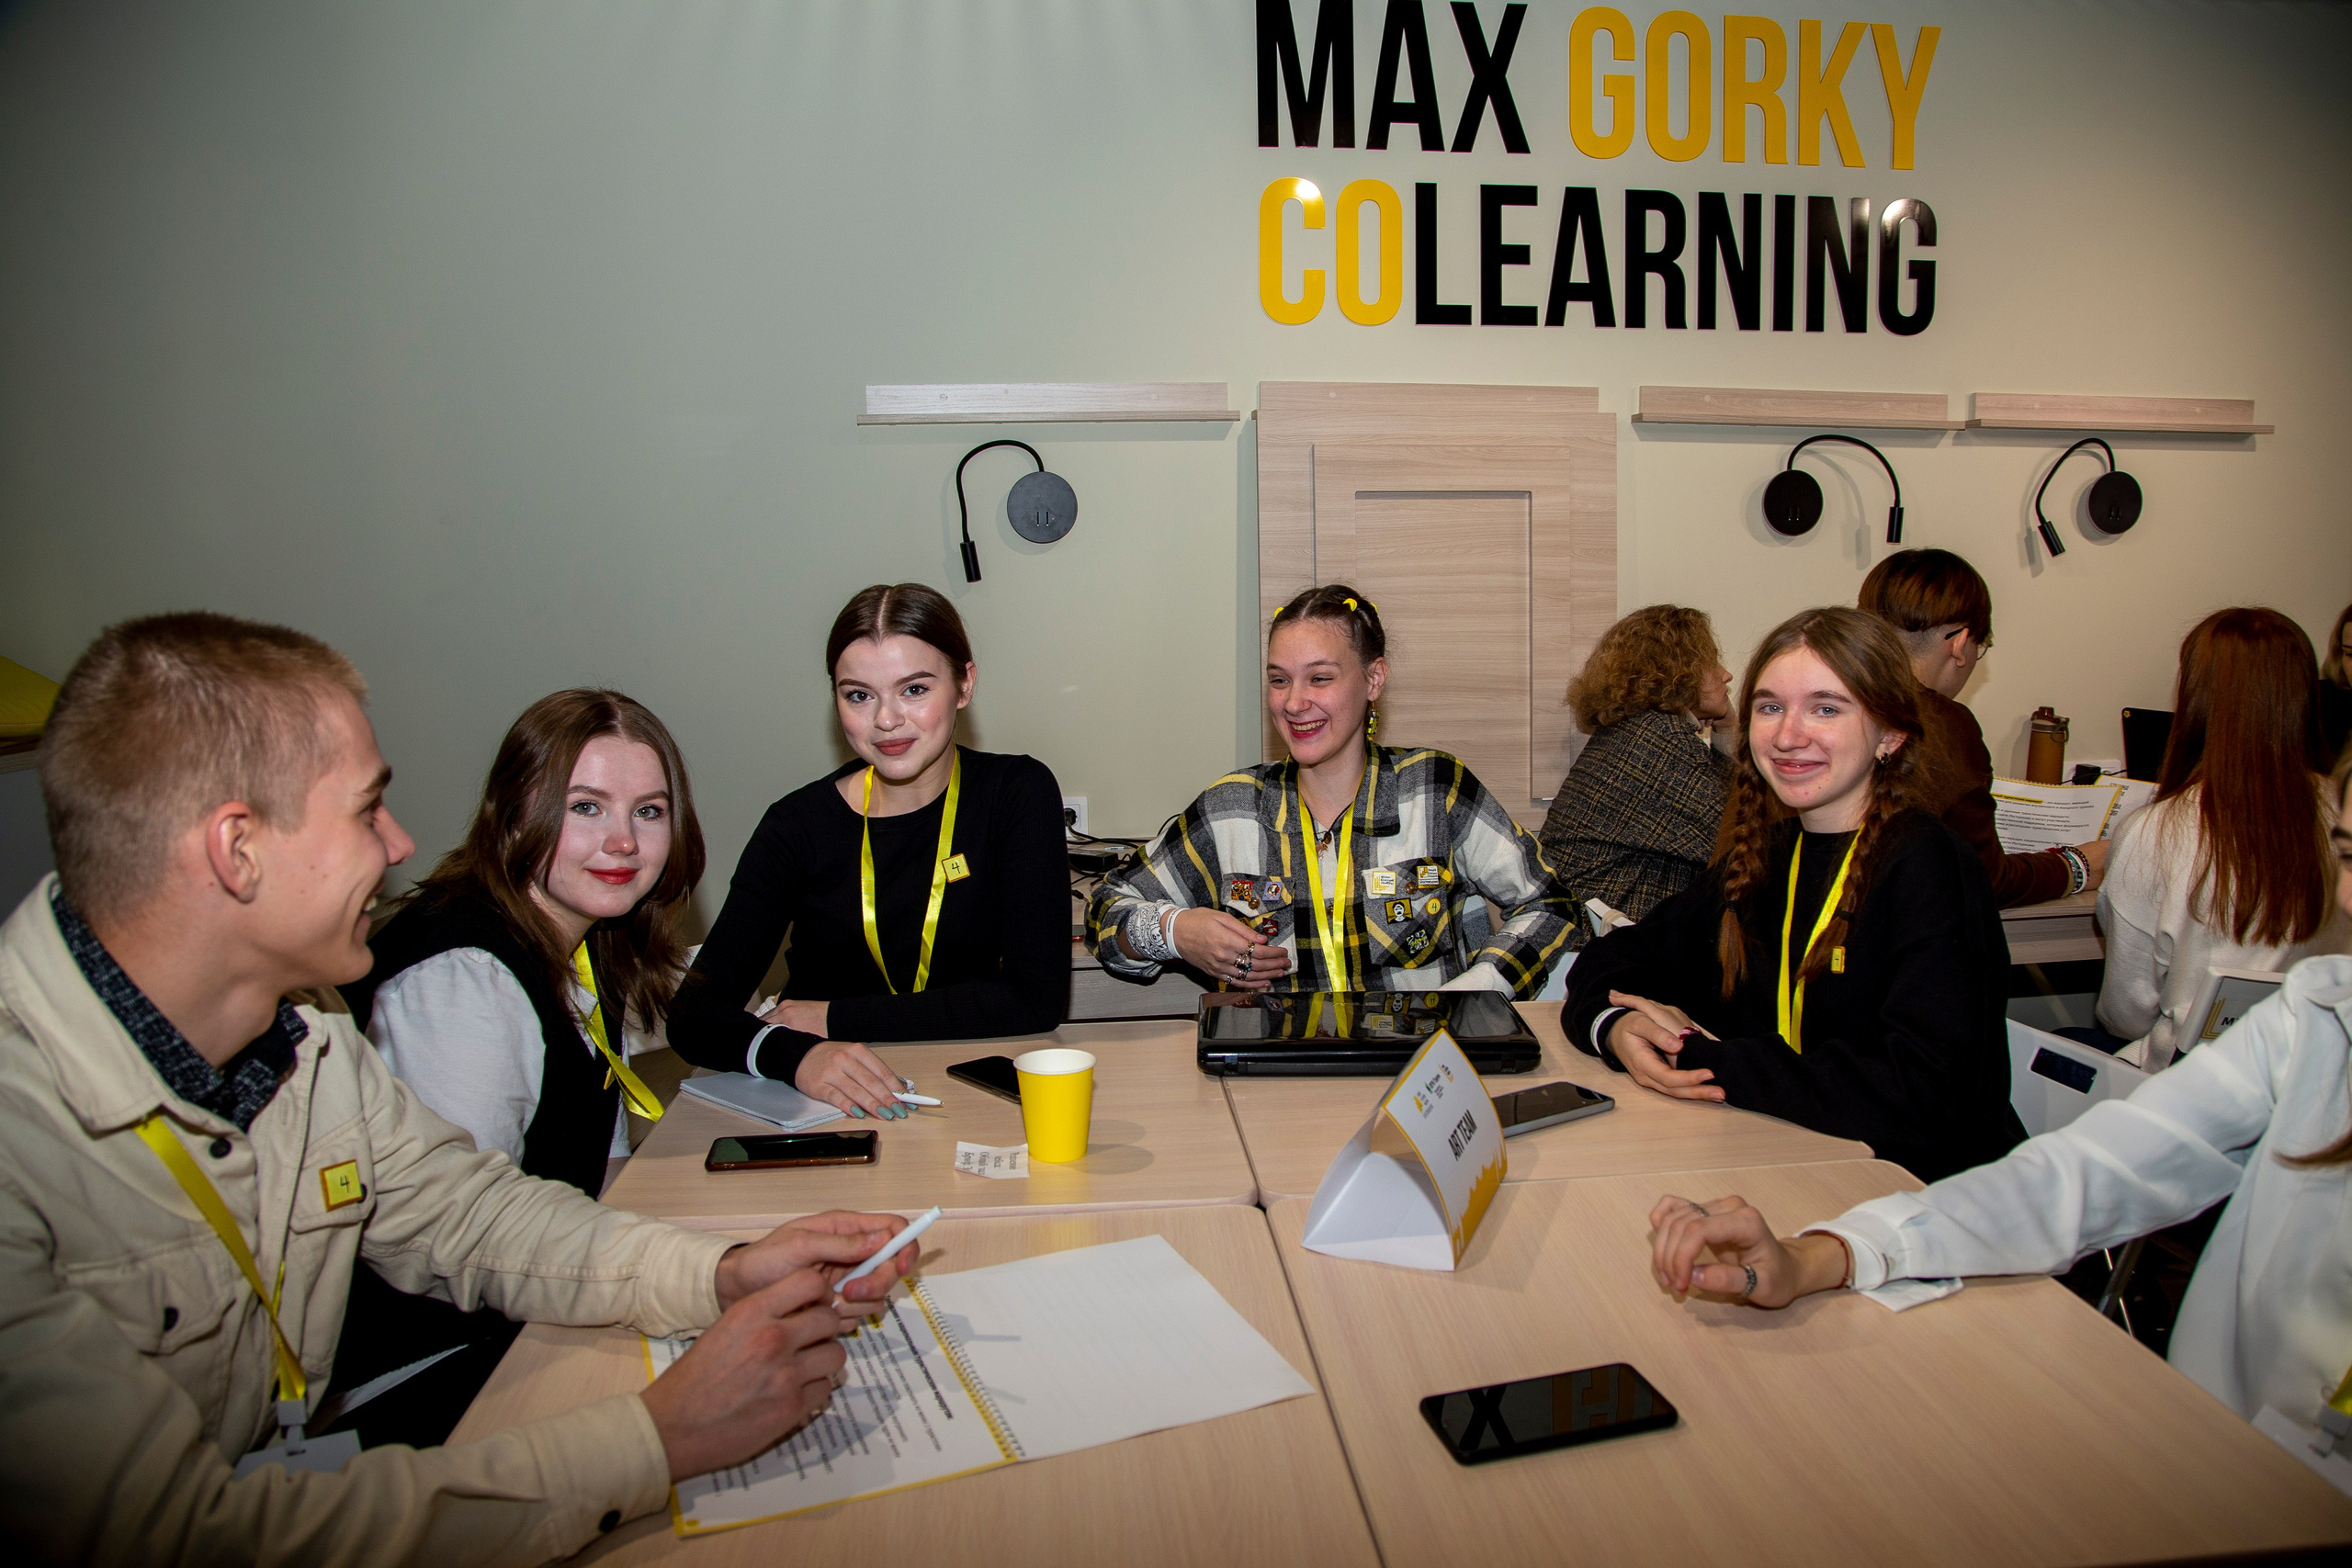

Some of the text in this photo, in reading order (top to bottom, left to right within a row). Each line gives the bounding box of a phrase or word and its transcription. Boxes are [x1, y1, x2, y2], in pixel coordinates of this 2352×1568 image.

[1257, 0, 1942, 171] MAX GORKY
[1258, 175, 1939, 337] COLEARNING
[952, 862, 961, 874] 4
[1447, 1108, 1478, 1162] ART TEAM
[339, 1175, 350, 1193] 4
